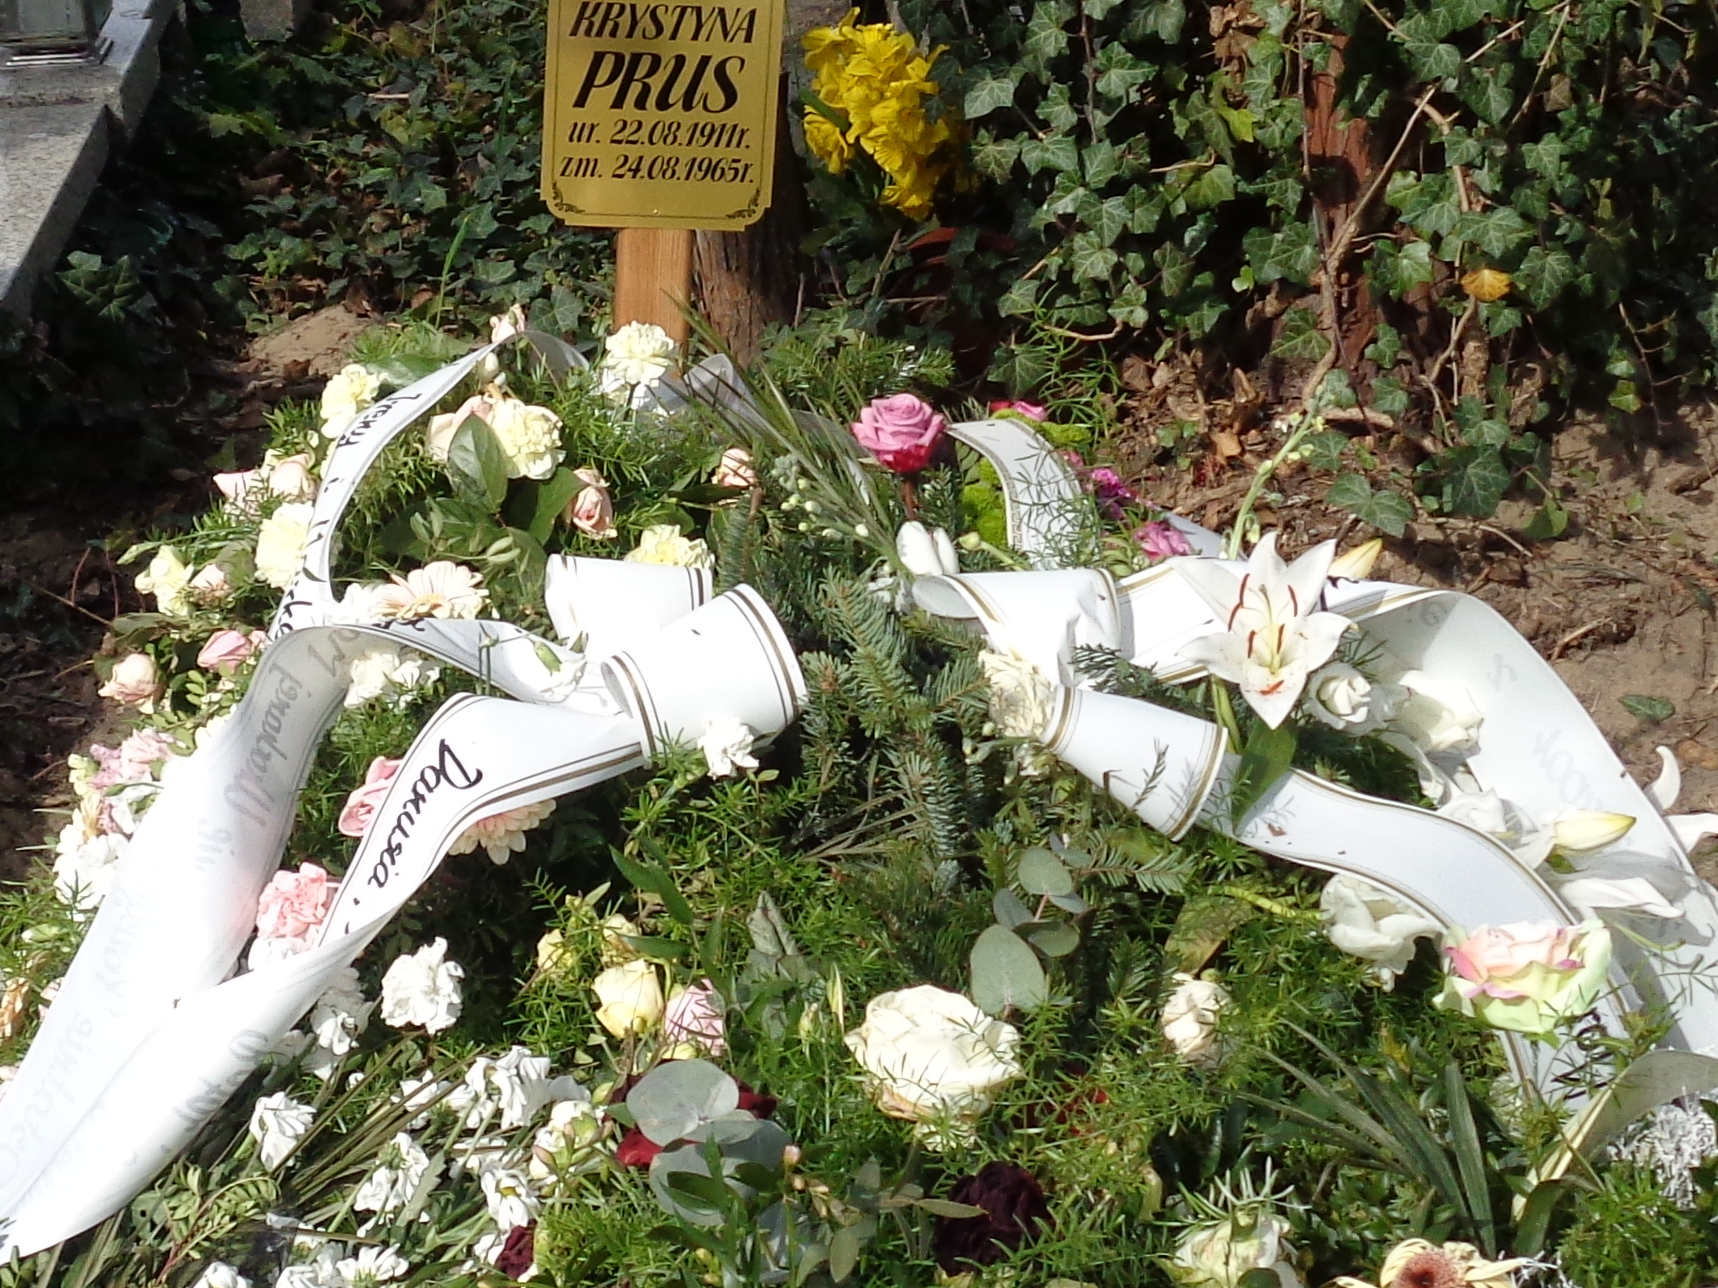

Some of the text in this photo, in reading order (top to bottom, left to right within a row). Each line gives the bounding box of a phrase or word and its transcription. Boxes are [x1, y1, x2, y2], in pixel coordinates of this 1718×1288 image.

[568, 0, 758, 44] KRYSTYNA
[571, 50, 747, 114] PRUS
[568, 118, 751, 150] ur. 22.08.1911r.
[558, 153, 755, 185] zm. 24.08.1965r.
[366, 738, 484, 889] Danusia
